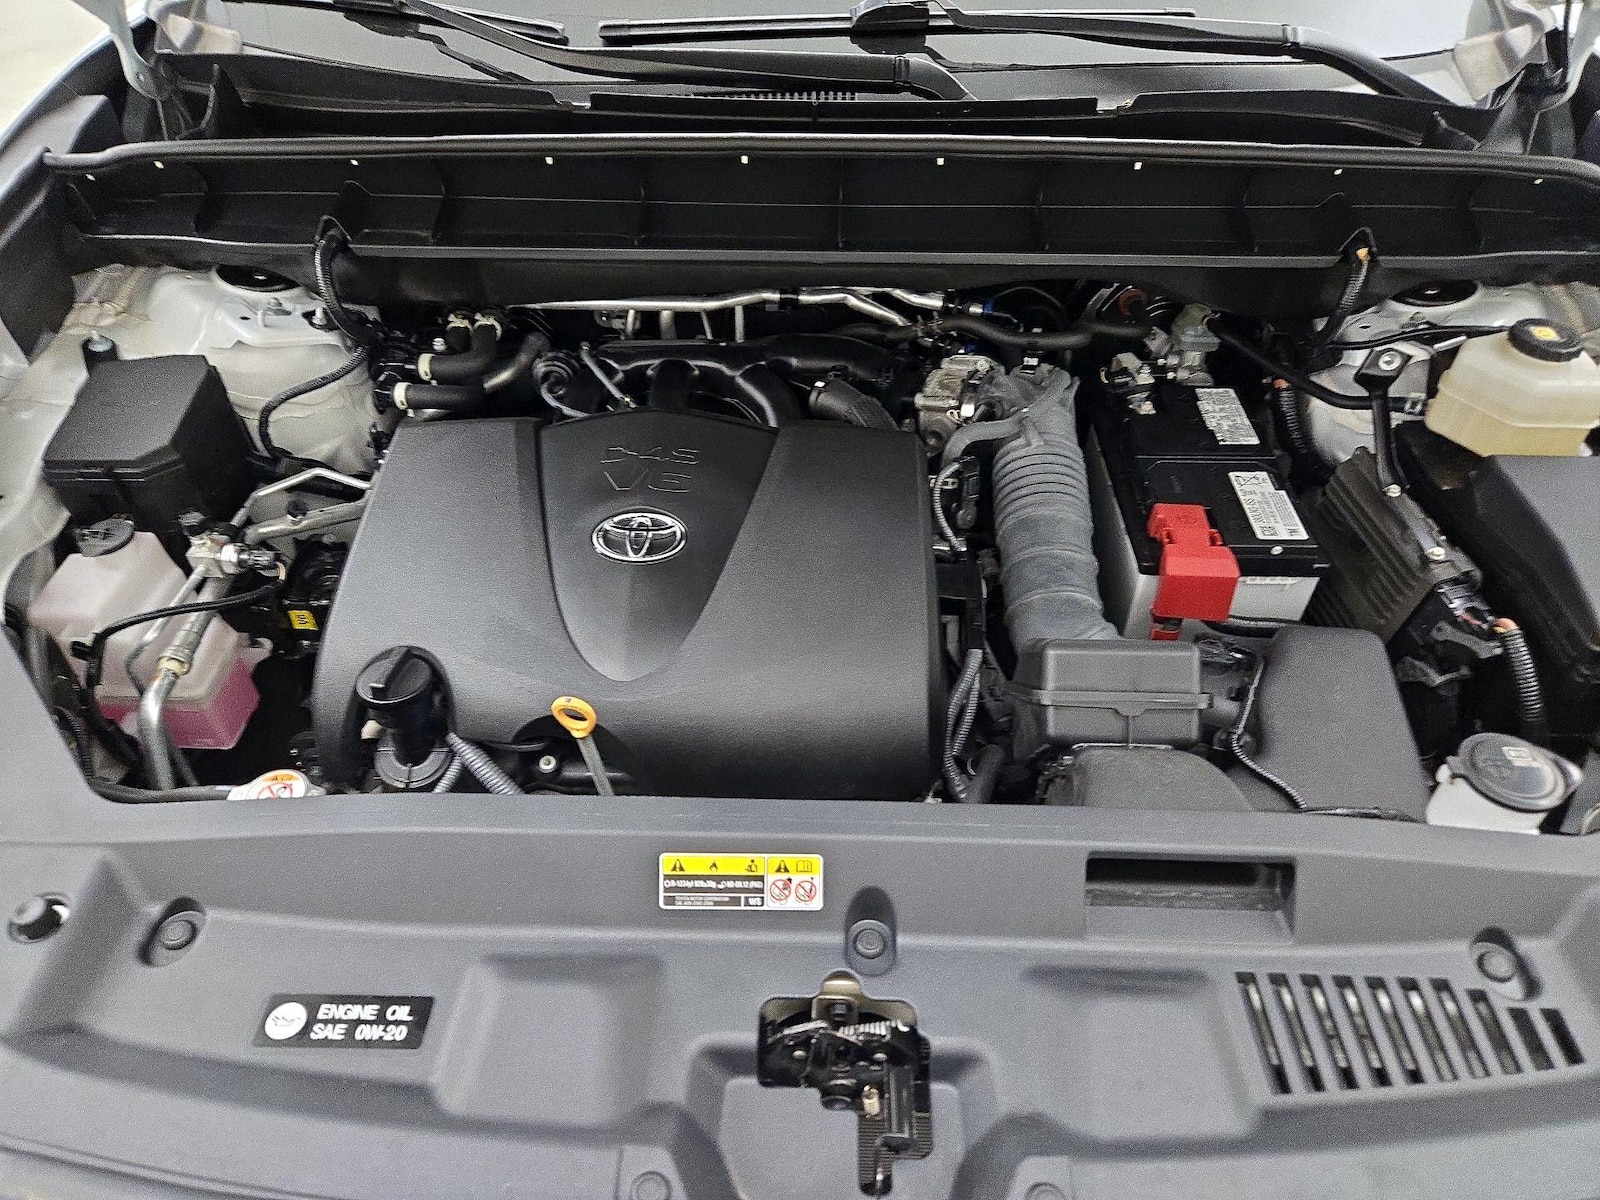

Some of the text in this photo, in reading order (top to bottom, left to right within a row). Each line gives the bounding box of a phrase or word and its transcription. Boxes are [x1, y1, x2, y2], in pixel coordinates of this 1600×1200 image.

[602, 468, 692, 494] V6
[316, 1003, 414, 1021] ENGINE OIL
[309, 1023, 408, 1041] SAE 0W-20
